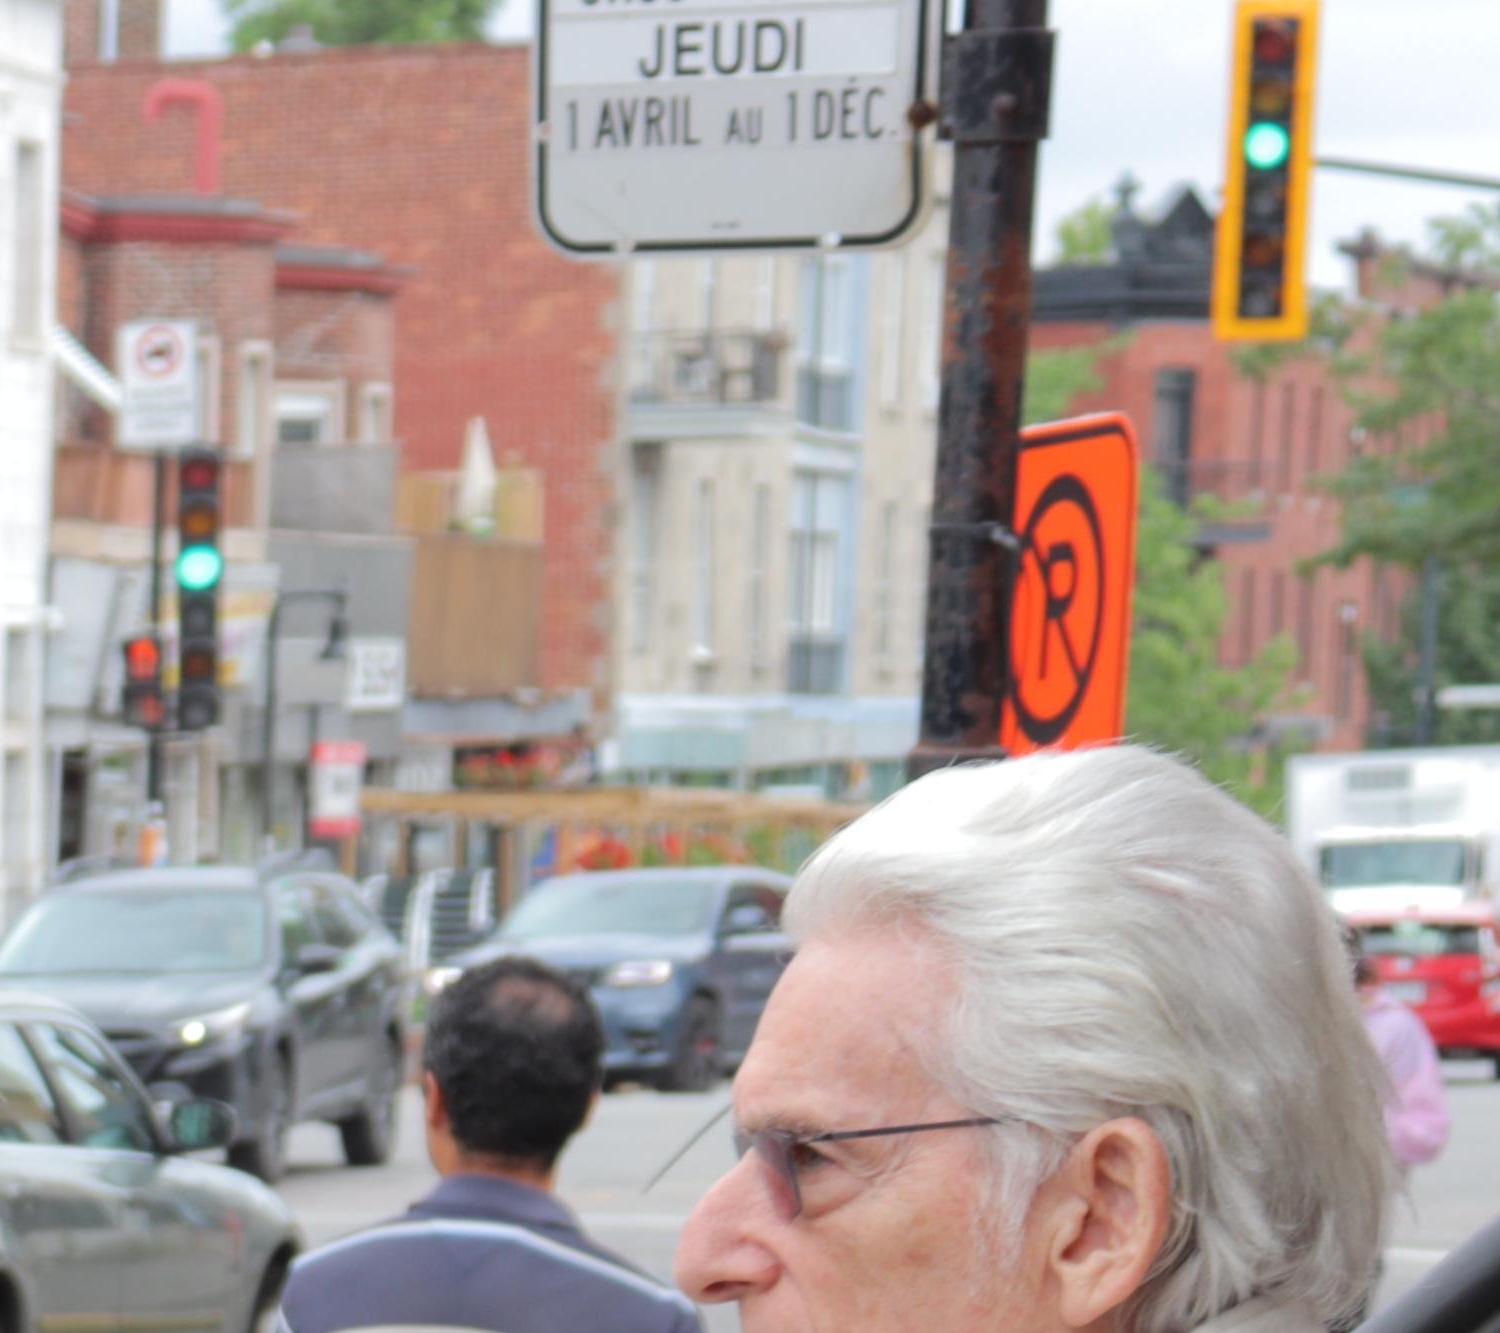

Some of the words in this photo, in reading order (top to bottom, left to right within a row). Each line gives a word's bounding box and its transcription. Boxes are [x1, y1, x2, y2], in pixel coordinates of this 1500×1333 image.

[637, 18, 804, 78] JEUDI
[566, 99, 579, 151] 1
[594, 93, 701, 149] AVRIL
[725, 107, 763, 145] AU
[786, 90, 798, 143] 1
